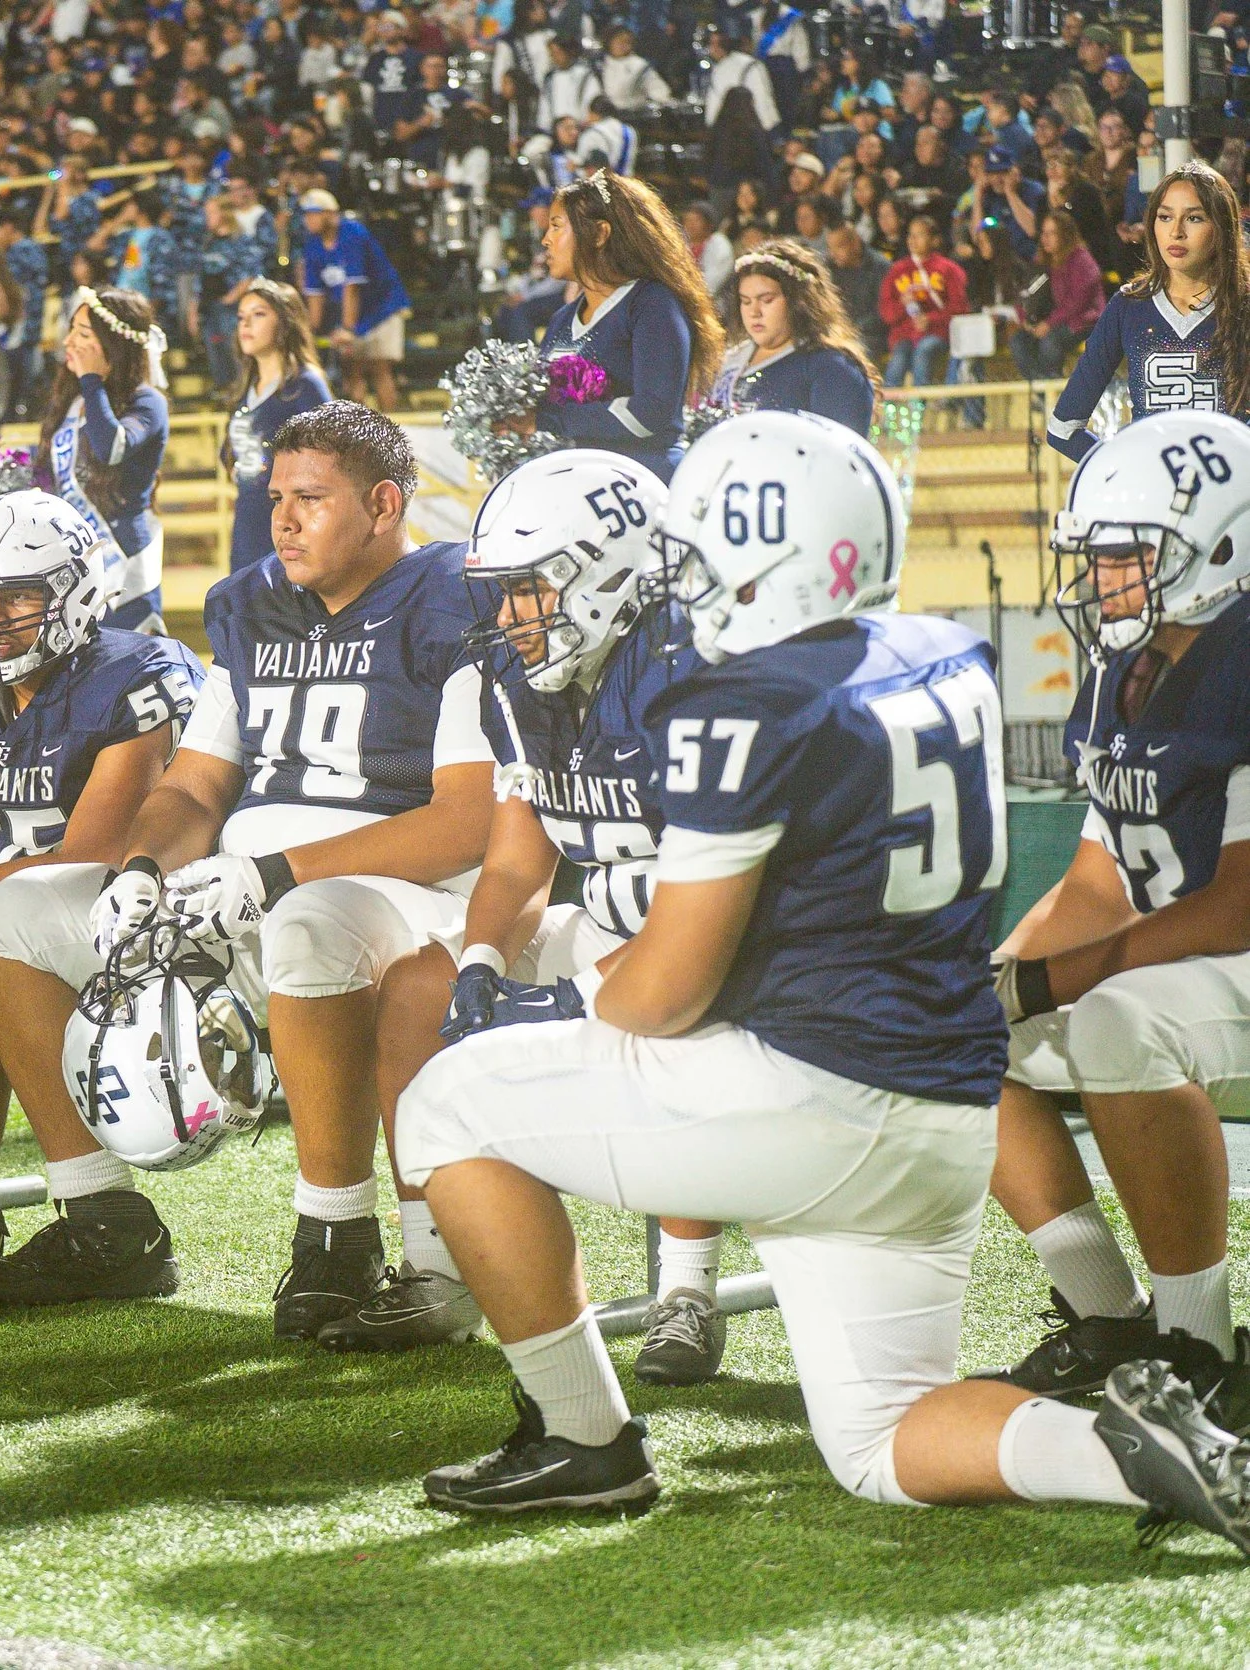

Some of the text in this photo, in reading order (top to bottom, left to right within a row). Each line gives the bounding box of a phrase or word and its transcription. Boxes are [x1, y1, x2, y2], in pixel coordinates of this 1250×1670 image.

[1160, 434, 1231, 496] 66
[584, 480, 647, 539] 56
[722, 481, 786, 546] 60
[254, 639, 376, 678] VALIANTS
[127, 672, 200, 732] 55
[245, 682, 371, 801] 79
[665, 718, 760, 793] 57
[866, 661, 1008, 914] 57
[242, 892, 262, 921] adidas
